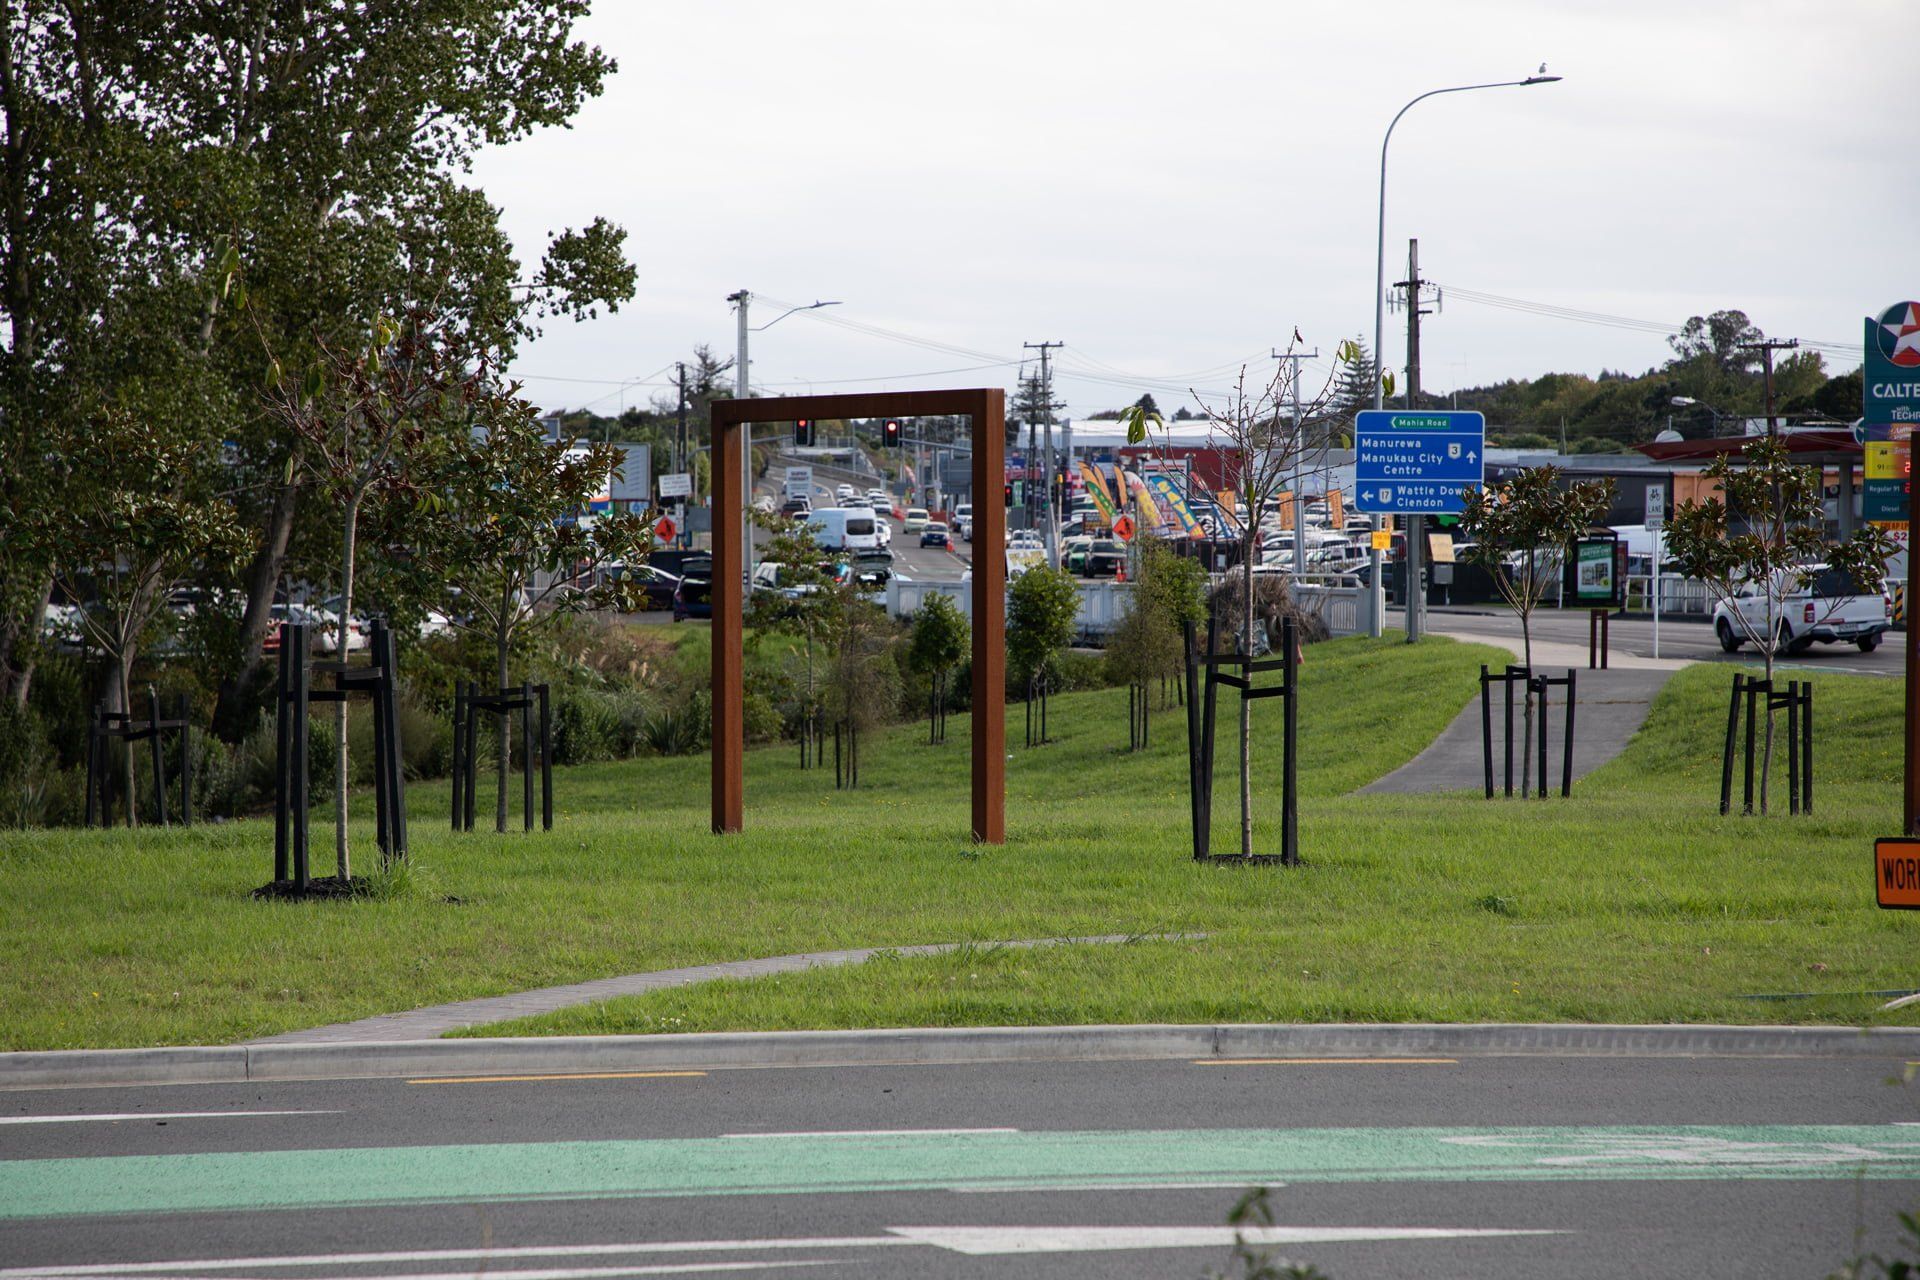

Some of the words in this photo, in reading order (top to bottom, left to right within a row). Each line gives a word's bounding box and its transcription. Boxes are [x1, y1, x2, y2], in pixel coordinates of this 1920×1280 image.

[1361, 438, 1422, 448] Manurewa
[1451, 446, 1458, 455] 3
[1361, 453, 1415, 463] Manukau
[1419, 453, 1443, 465] City
[1383, 465, 1422, 475] Centre
[1397, 486, 1435, 495] Wattle
[1869, 485, 1892, 494] Regular
[1381, 490, 1390, 500] 17
[1397, 498, 1443, 507] Clendon
[1648, 505, 1662, 513] LANE
[1882, 858, 1920, 890] WOR
